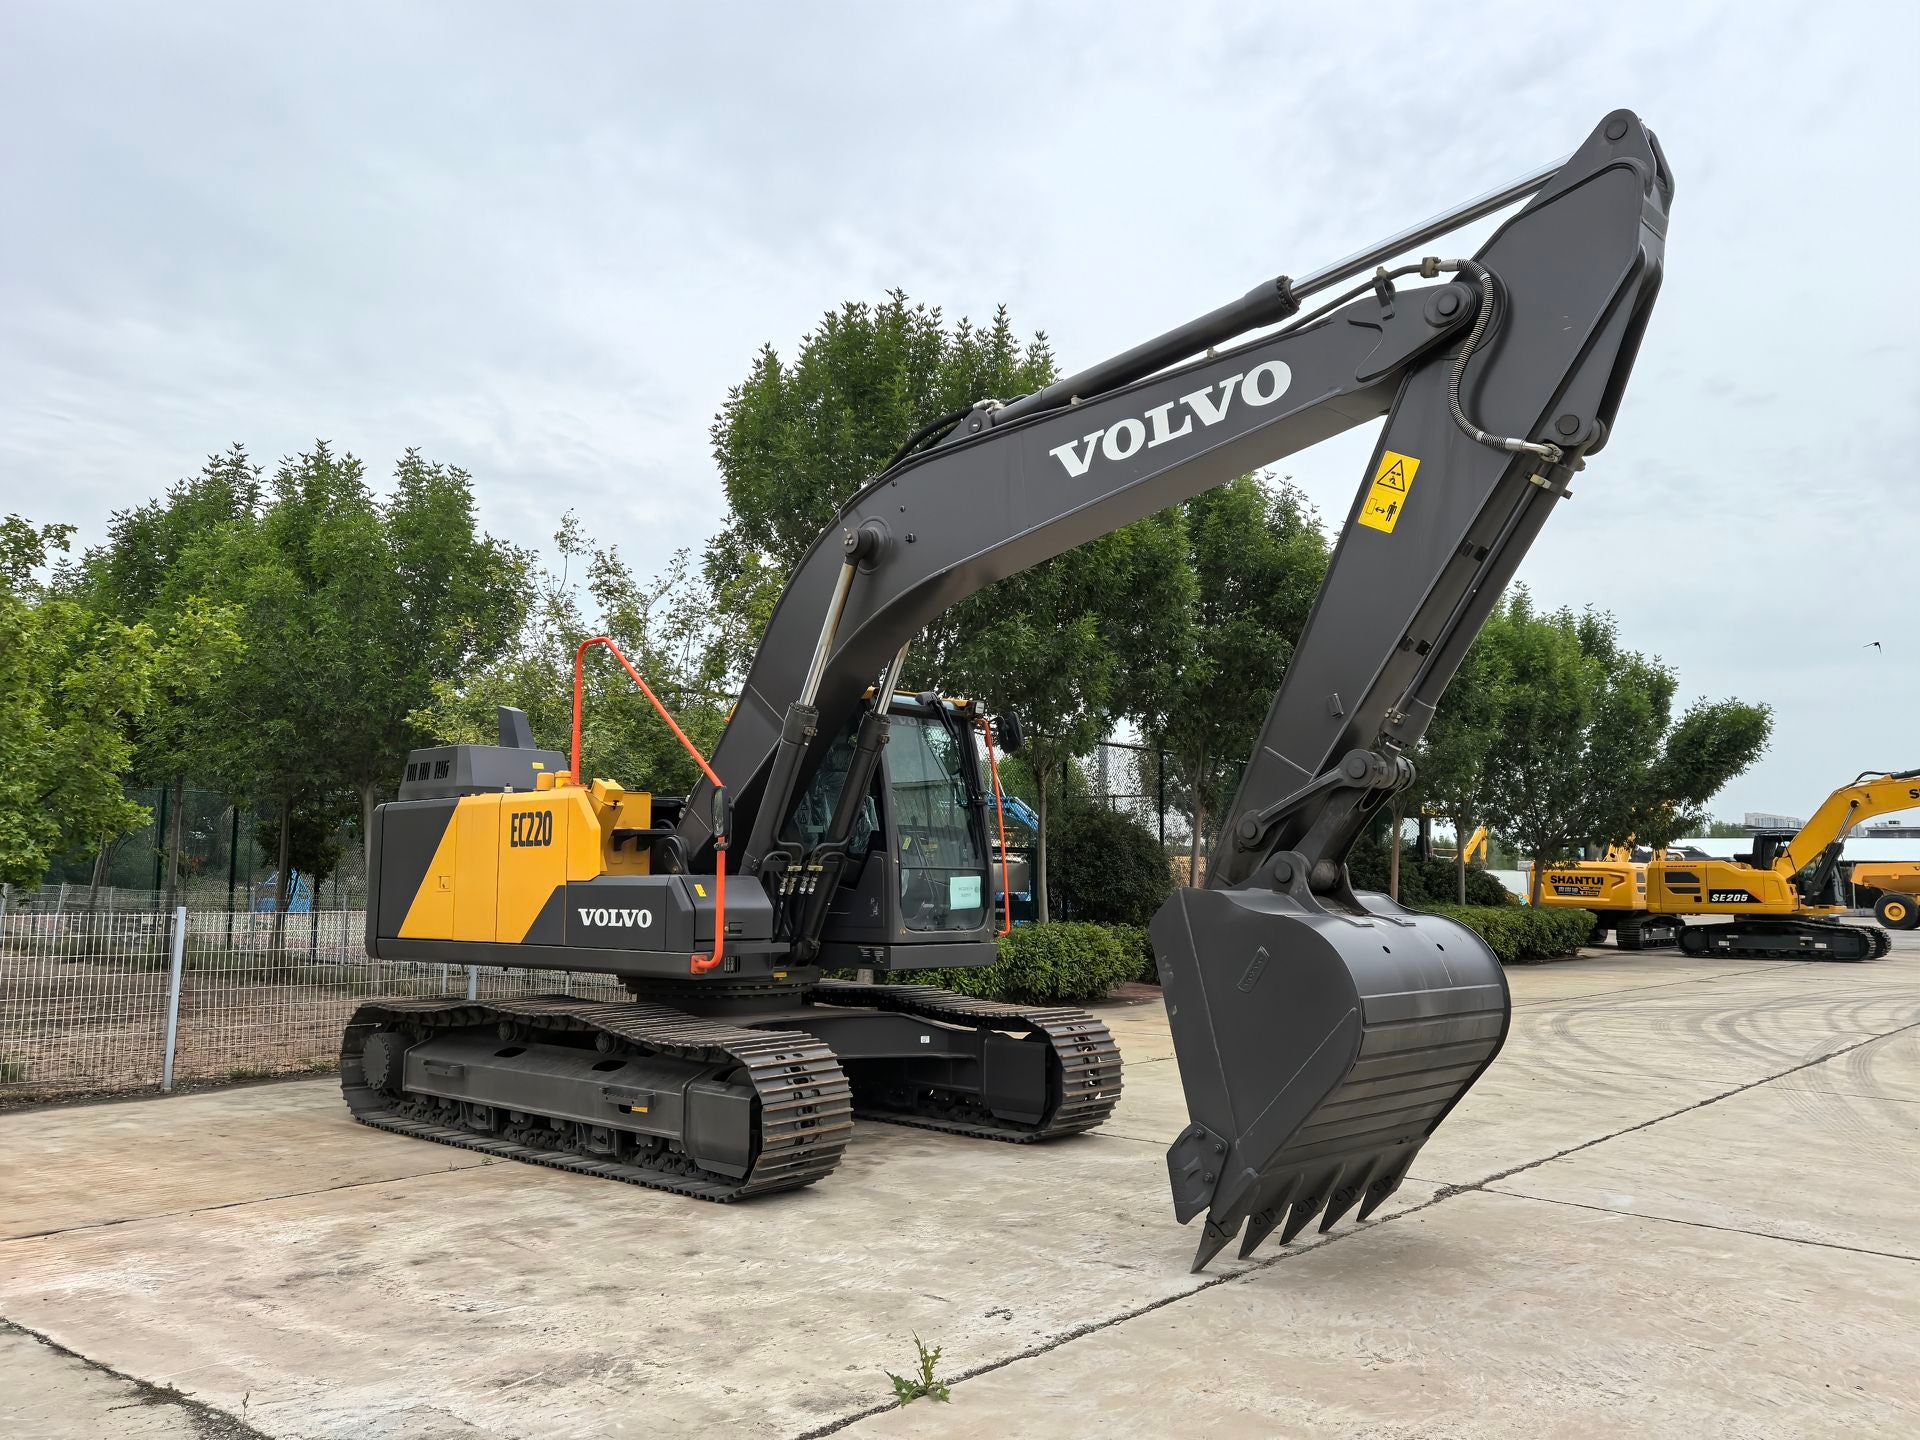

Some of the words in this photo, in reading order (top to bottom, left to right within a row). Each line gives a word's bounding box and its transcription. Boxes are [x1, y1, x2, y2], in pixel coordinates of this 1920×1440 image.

[1049, 360, 1292, 478] VOLVO
[1909, 788, 1920, 799] S
[510, 810, 553, 847] EC220
[1550, 875, 1604, 885] SHANTUI
[1711, 893, 1749, 902] SE205
[577, 908, 653, 929] VOLVO
